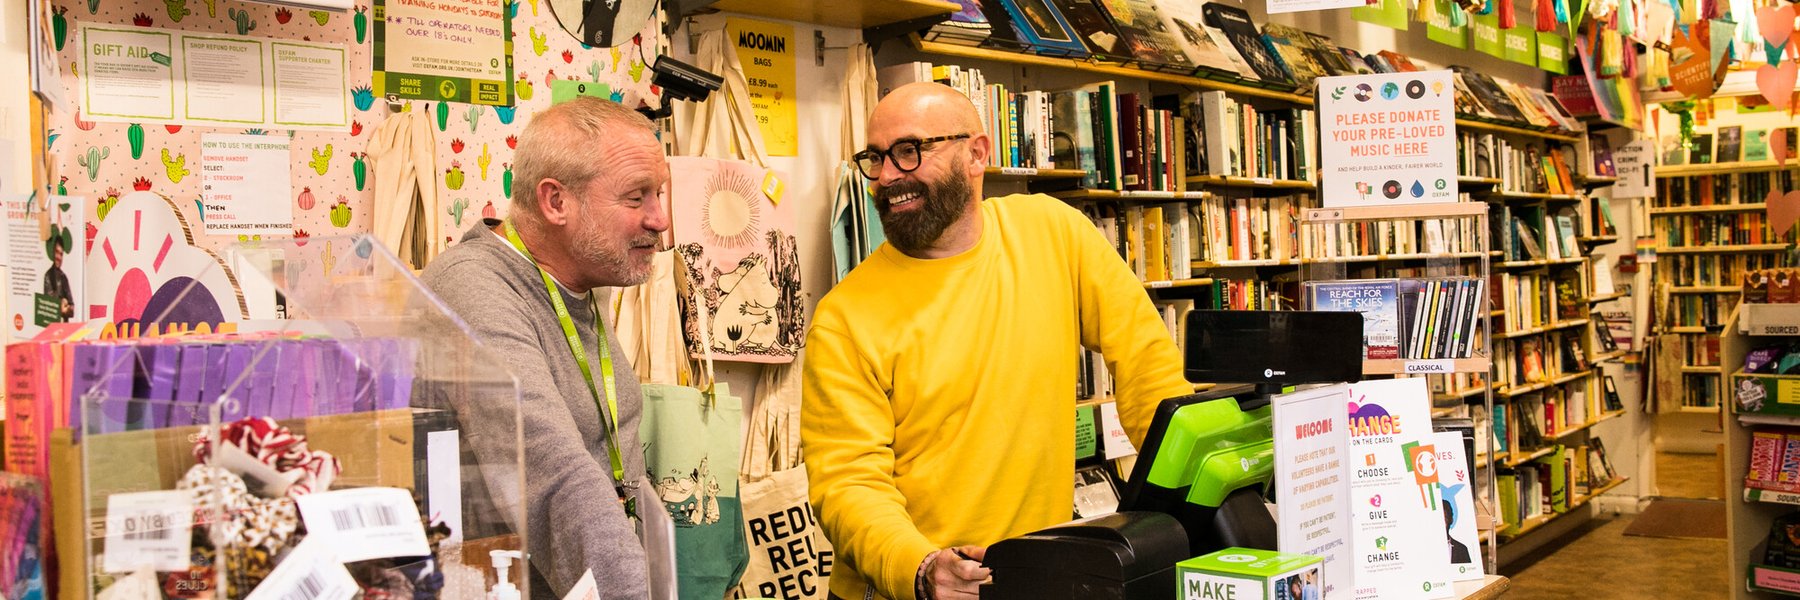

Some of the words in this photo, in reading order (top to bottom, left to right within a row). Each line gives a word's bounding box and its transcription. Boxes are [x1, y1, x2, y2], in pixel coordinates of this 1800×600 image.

[438, 4, 469, 15] MONDAYS
[406, 16, 425, 26] TILL
[428, 19, 473, 32] OPERATORS
[406, 28, 429, 38] OVER
[738, 30, 786, 54] MOOMIN
[93, 43, 123, 57] GIFT
[127, 46, 149, 59] AID
[206, 43, 228, 51] REFUND
[229, 45, 248, 53] POLICY
[278, 55, 308, 64] SUPPORTER
[753, 57, 772, 67] BAGS
[400, 78, 422, 86] SHARE
[748, 77, 768, 88] £8.99
[1684, 70, 1710, 86] TITLES
[400, 86, 422, 95] SKILLS
[482, 84, 496, 92] REAL
[480, 93, 498, 101] IMPACT
[1336, 112, 1386, 126] PLEASE
[1390, 109, 1441, 123] DONATE
[1333, 129, 1366, 142] YOUR
[1370, 125, 1445, 140] PRE-LOVED
[203, 141, 217, 149] HOW
[1350, 143, 1391, 157] MUSIC
[1394, 142, 1429, 155] HERE
[1616, 145, 1643, 153] FICTION
[1338, 165, 1349, 173] AND
[1363, 164, 1378, 172] BUILD
[1618, 167, 1639, 175] SCI-FI
[205, 204, 226, 212] THEN
[1330, 290, 1361, 299] REACH
[1364, 289, 1382, 298] FOR
[1331, 299, 1352, 308] THE
[1355, 298, 1383, 308] SKIES
[1764, 326, 1799, 335] SOURCED
[1408, 364, 1444, 372] CLASSICAL
[1295, 417, 1333, 440] WELCOME
[1362, 437, 1373, 445] THE
[1374, 436, 1394, 444] CARDS
[1294, 452, 1309, 465] PLEASE
[1436, 450, 1456, 461] VES.
[1291, 466, 1315, 481] VOLUNTEERS
[1357, 467, 1389, 479] CHOOSE
[1374, 496, 1380, 506] 2
[1369, 510, 1388, 520] GIVE
[1379, 538, 1385, 547] 3
[1367, 551, 1400, 563] CHANGE
[1188, 579, 1236, 600] MAKE
